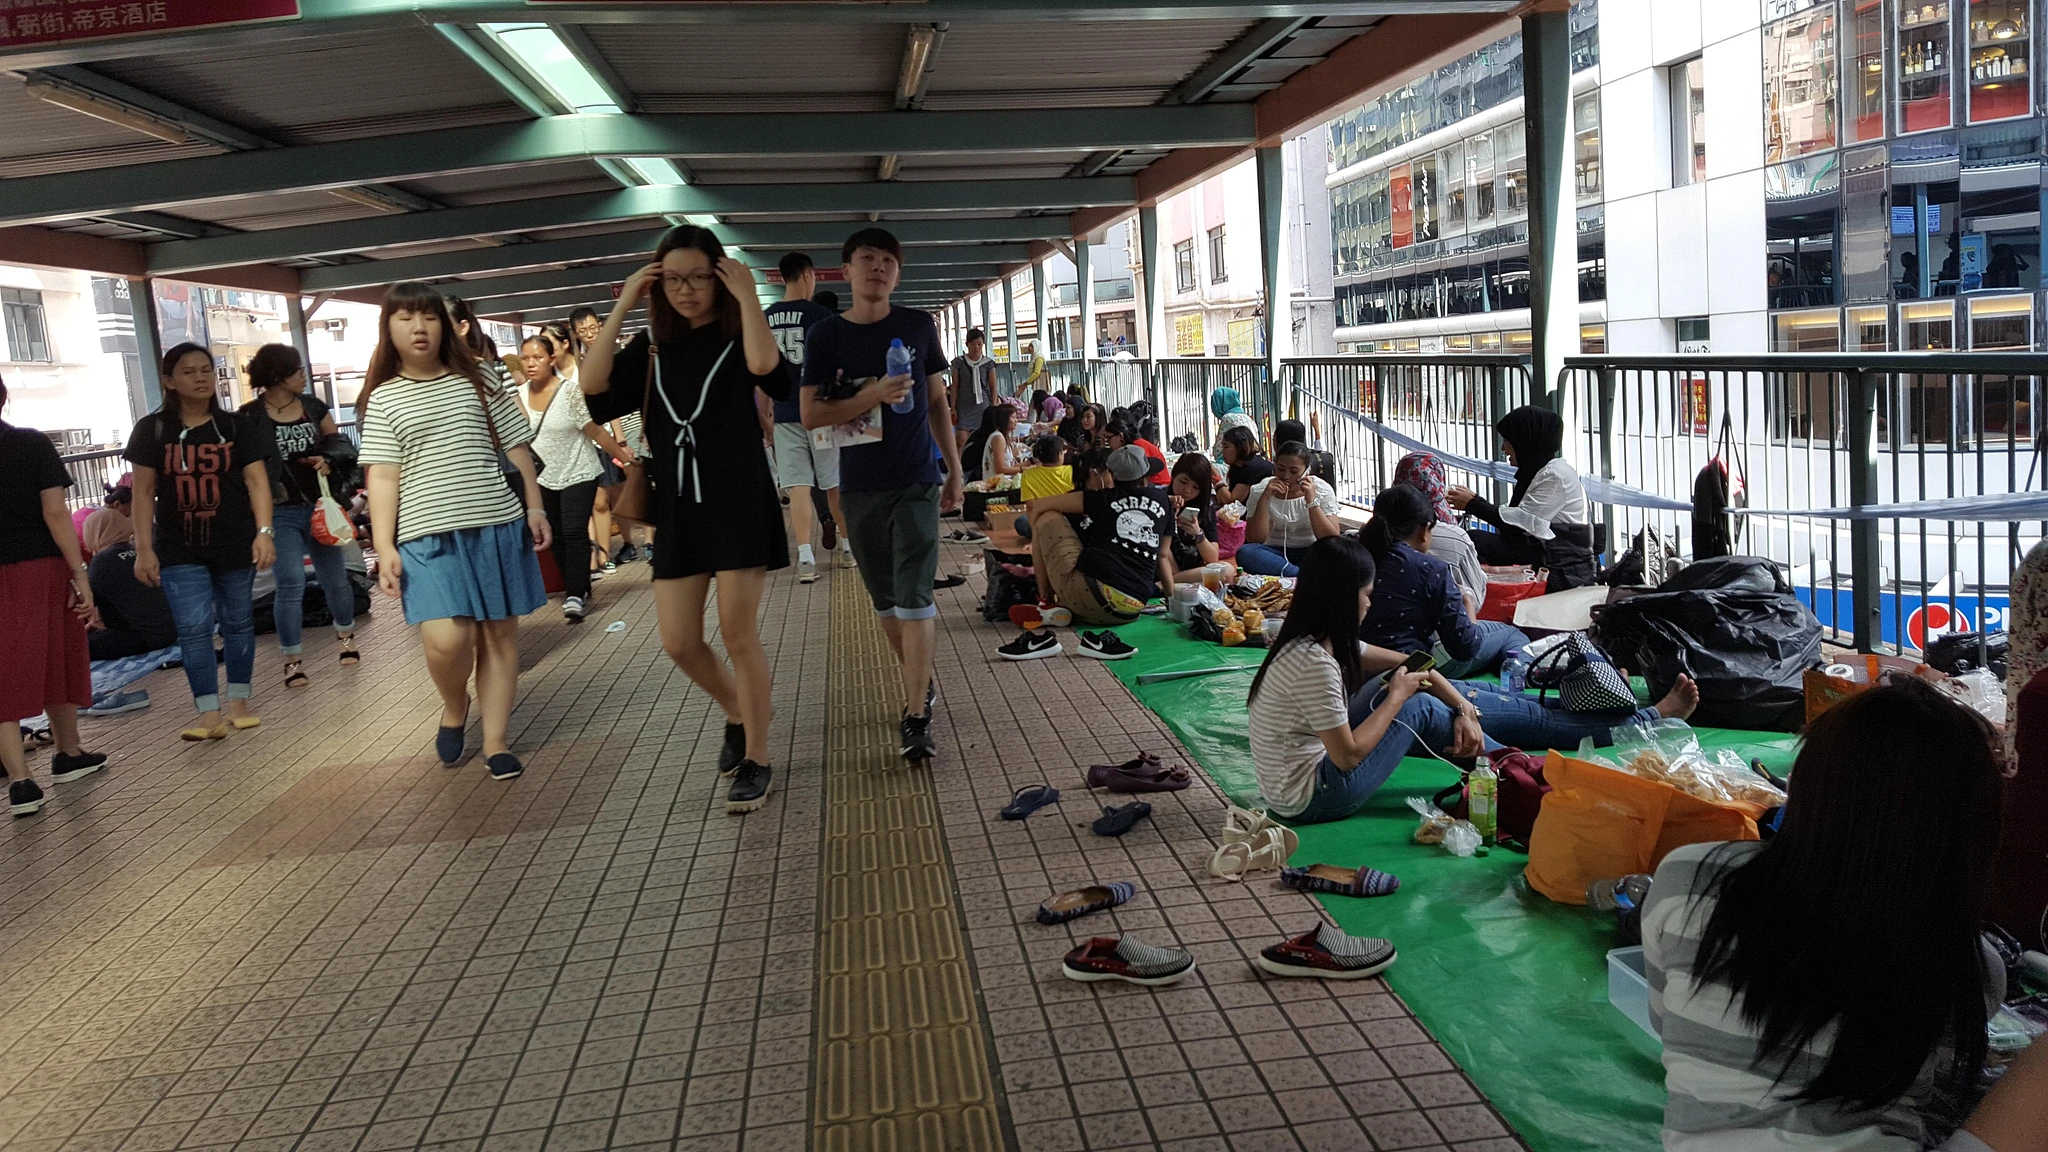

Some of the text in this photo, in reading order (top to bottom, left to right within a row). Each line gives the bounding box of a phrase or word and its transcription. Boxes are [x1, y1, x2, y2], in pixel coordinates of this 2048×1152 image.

[768, 311, 804, 327] DURANT
[164, 442, 235, 475] JUST
[175, 474, 221, 511] DO
[1110, 495, 1166, 519] STREET
[183, 509, 217, 546] IT
